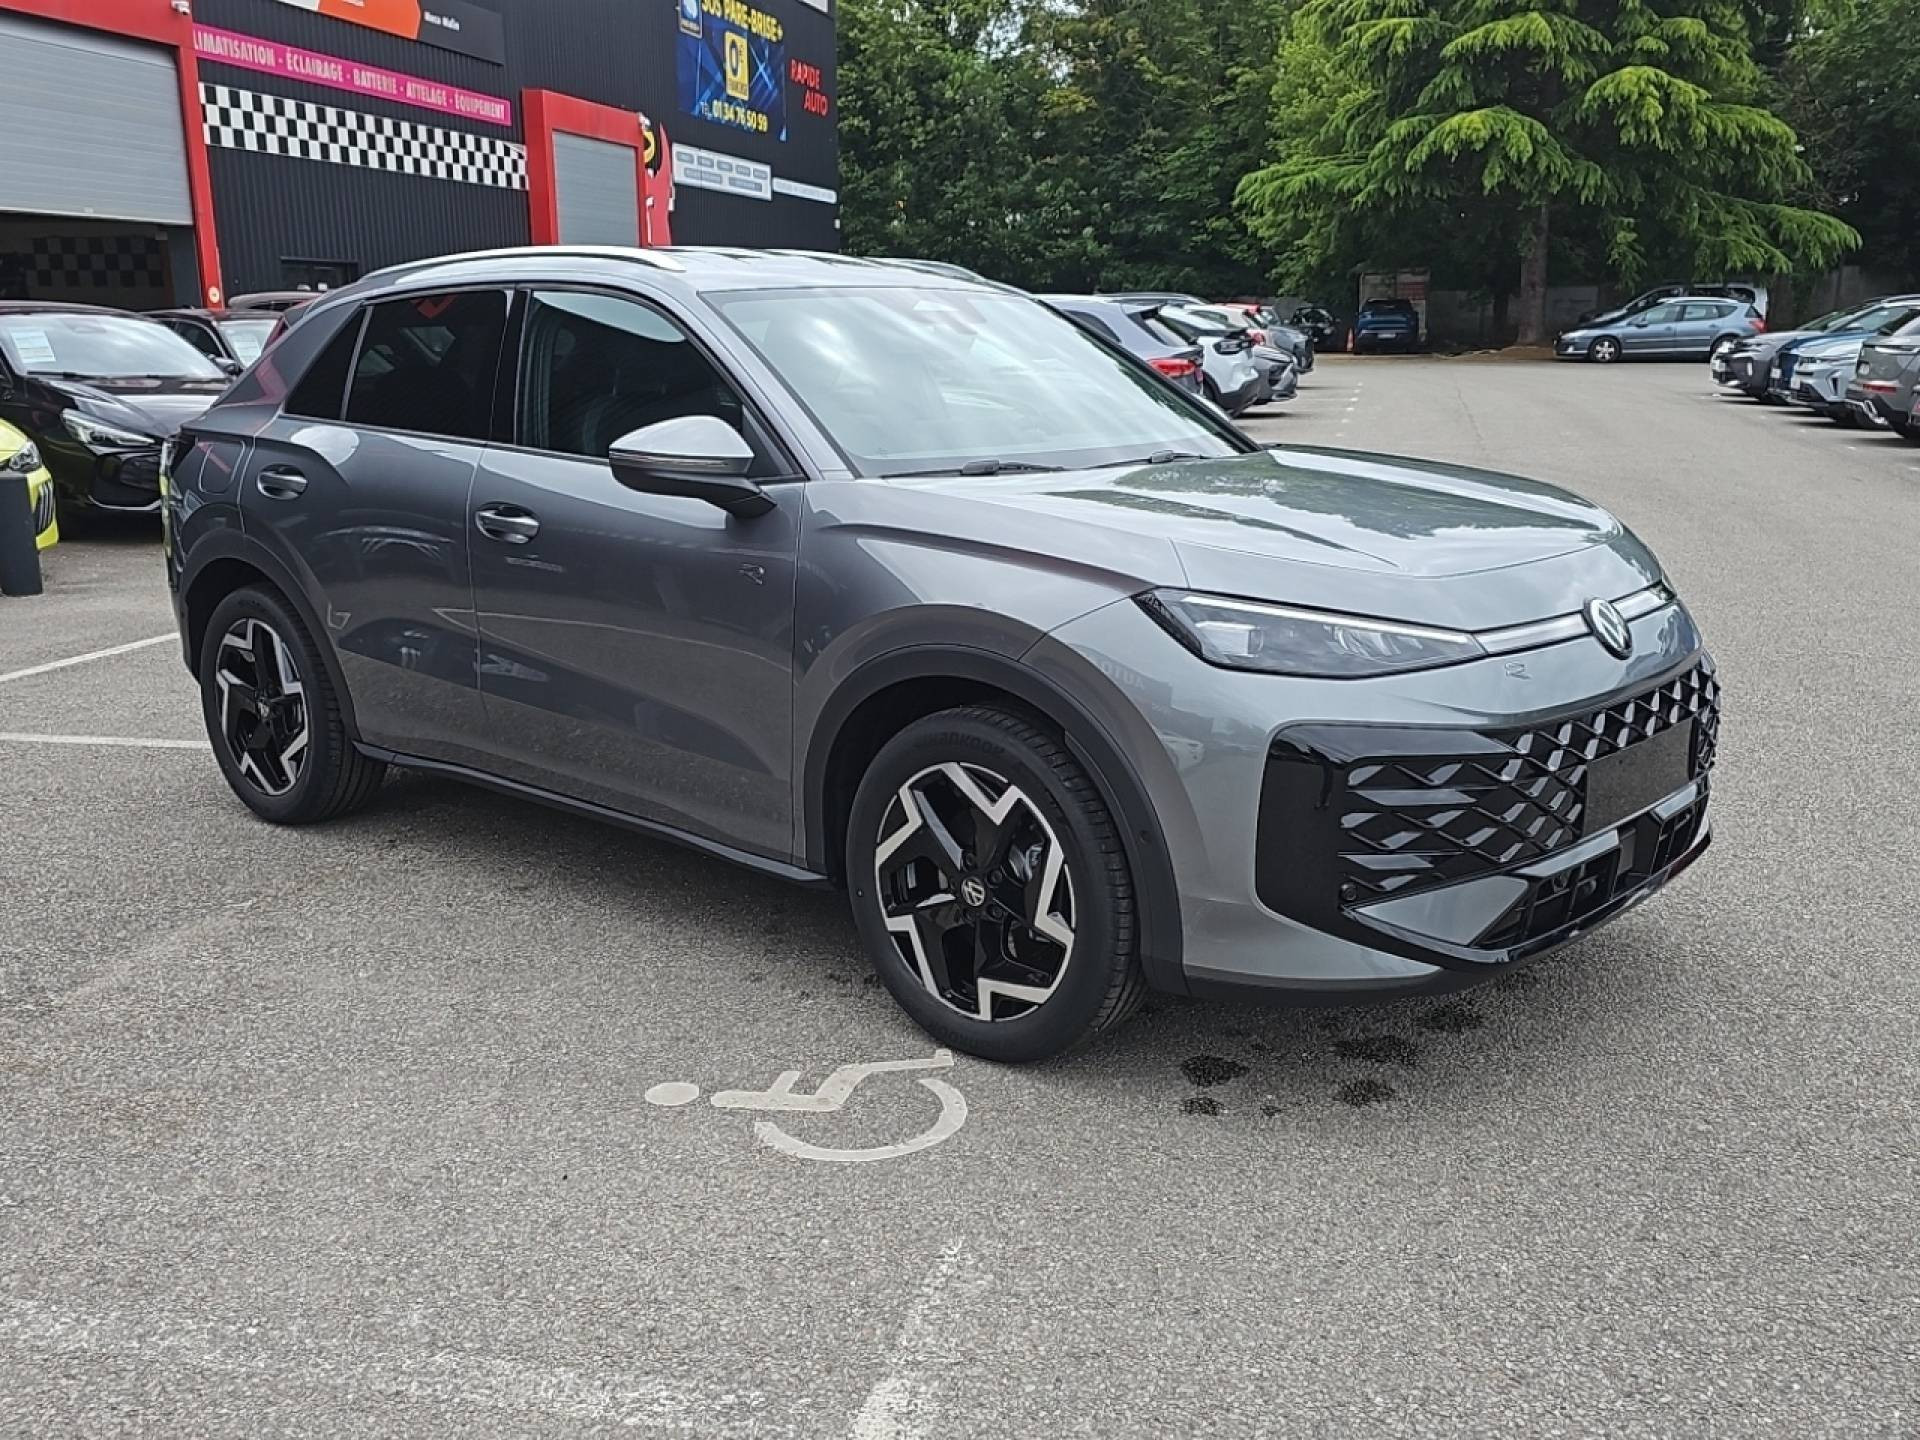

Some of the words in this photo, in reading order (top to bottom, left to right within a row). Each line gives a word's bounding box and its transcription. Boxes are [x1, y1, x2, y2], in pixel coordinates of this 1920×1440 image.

[193, 29, 276, 67] LIMATISATION
[286, 47, 343, 82] ÉCLAIRAGE
[353, 68, 398, 95] BATTERIE
[791, 58, 821, 91] RAPIDE
[803, 90, 829, 117] AUTO
